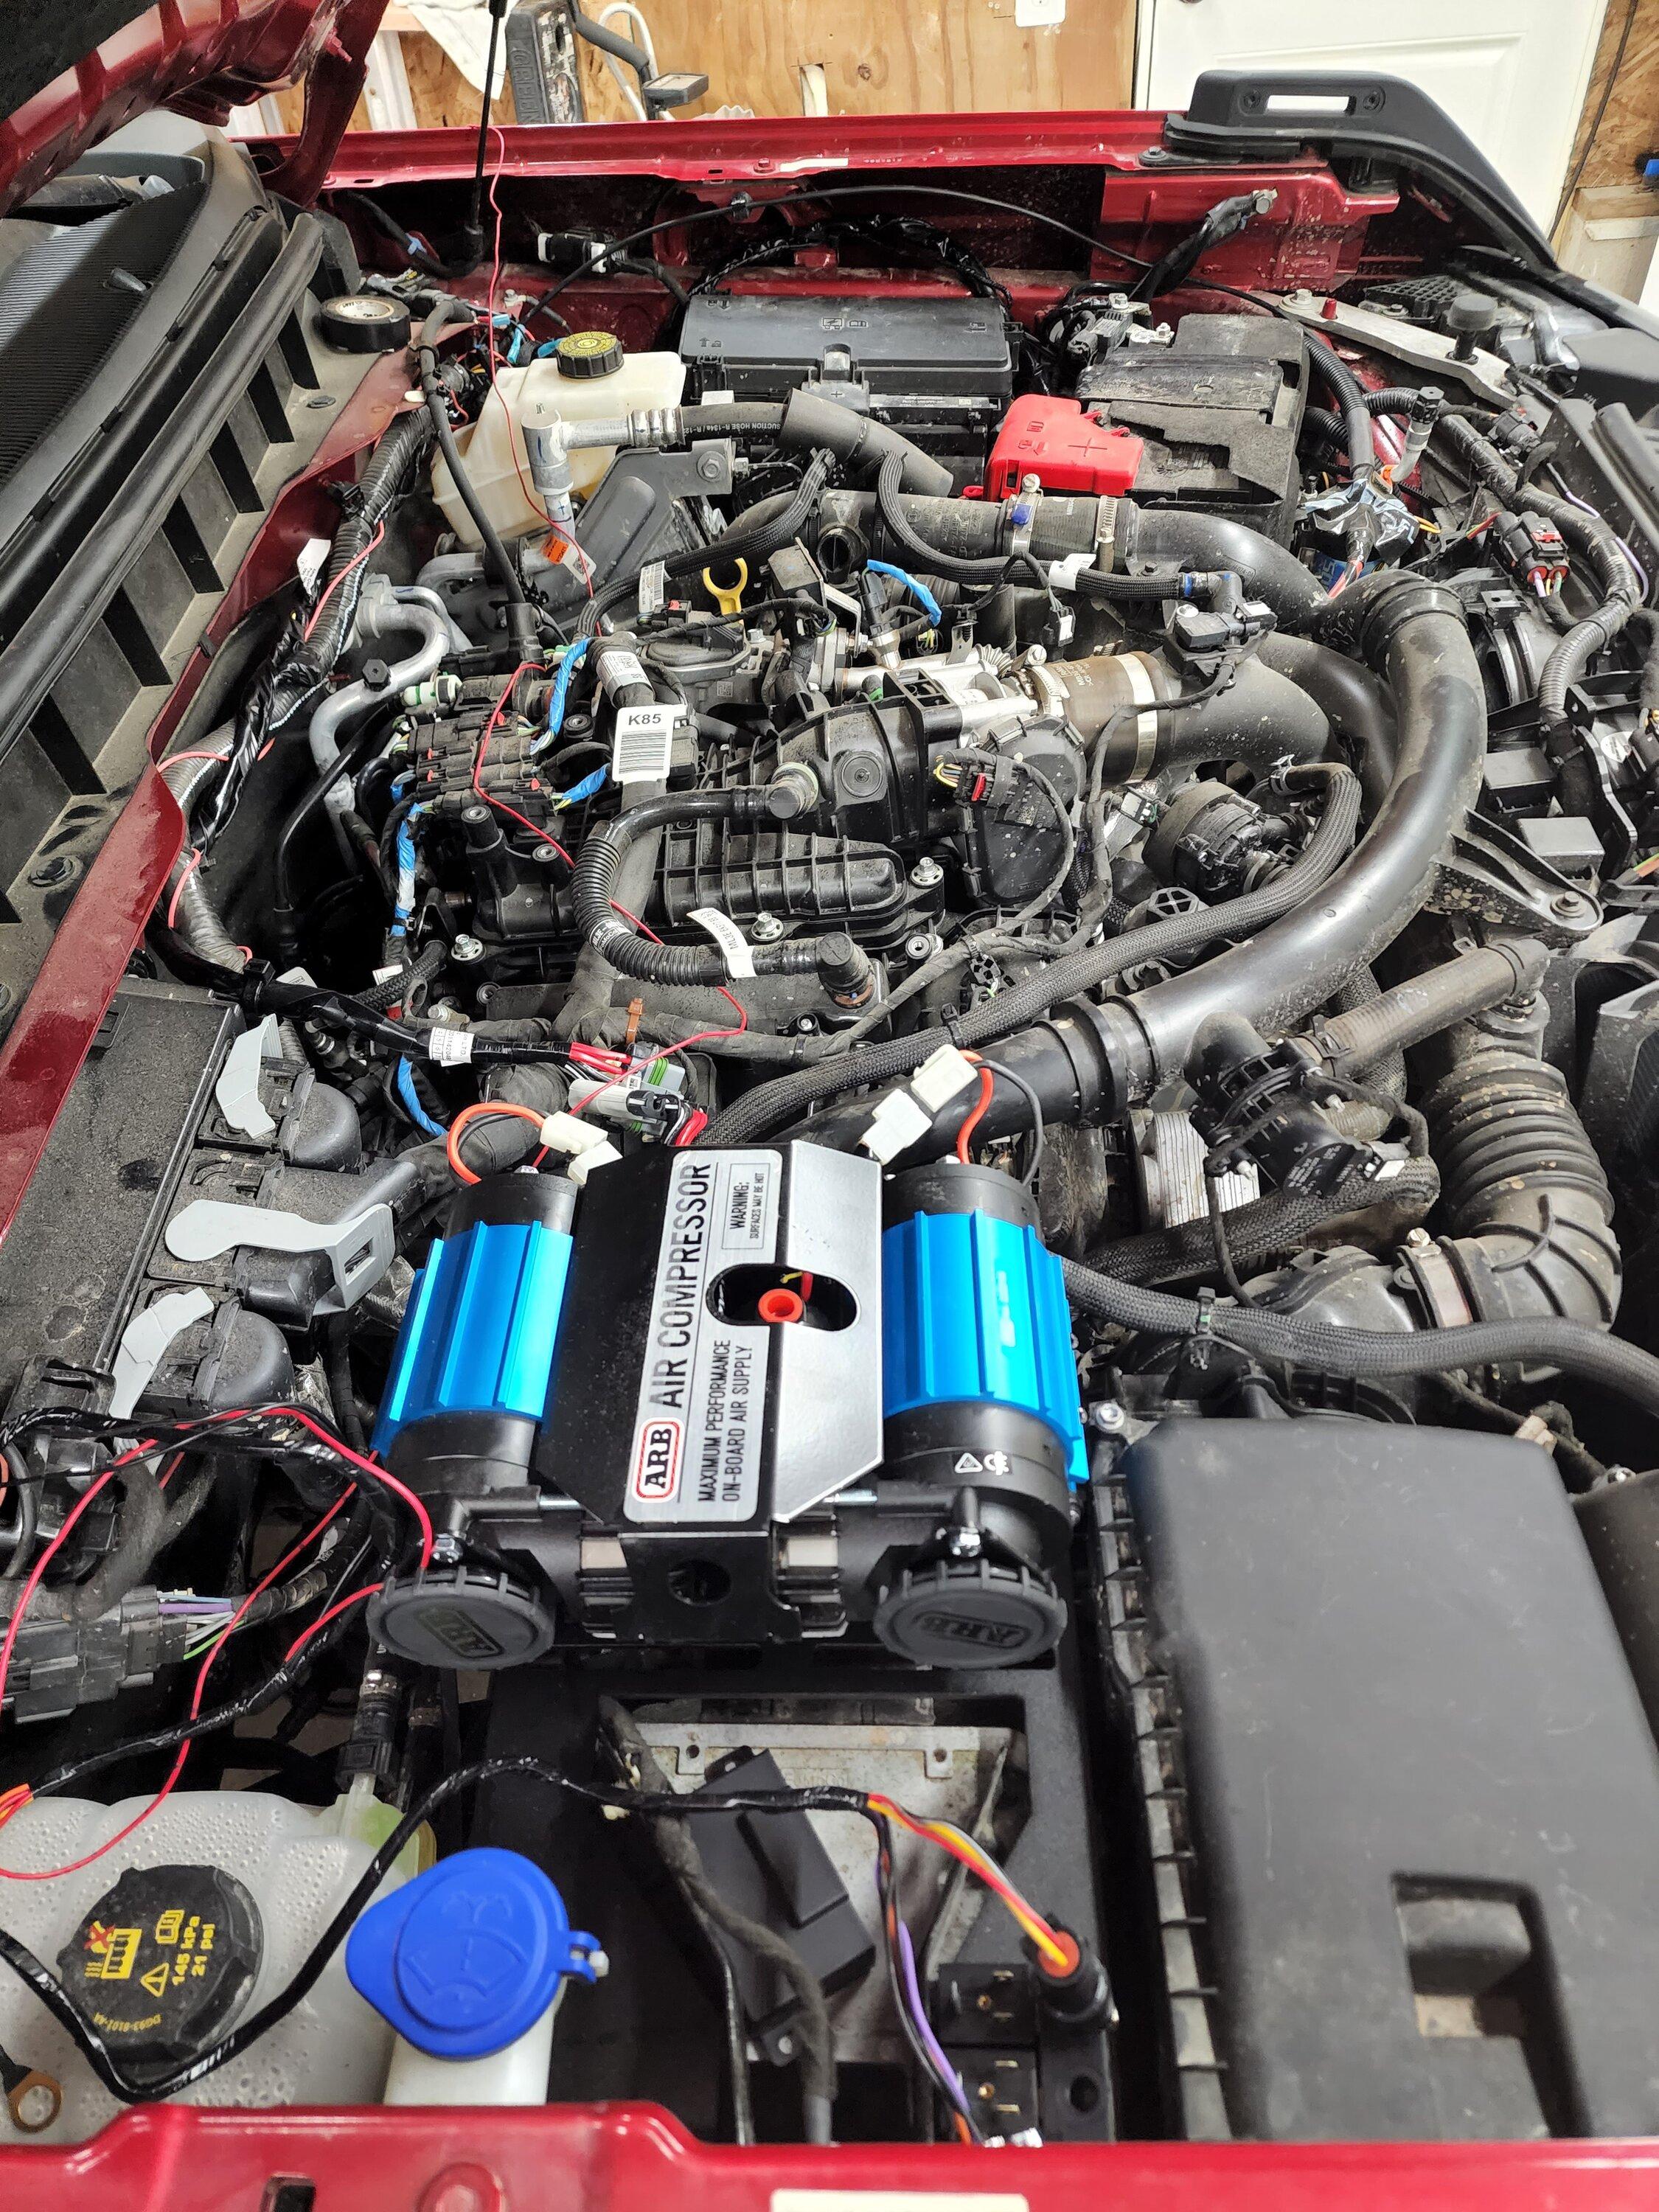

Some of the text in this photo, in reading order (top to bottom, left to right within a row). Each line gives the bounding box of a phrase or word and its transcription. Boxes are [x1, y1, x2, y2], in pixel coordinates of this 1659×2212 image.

[731, 422, 750, 431] HOSE
[751, 422, 781, 431] SUCTION
[628, 713, 661, 726] K85
[730, 1181, 750, 1230] WARNING:
[750, 1172, 765, 1239] SURFACES MAY BE HOT
[650, 1164, 712, 1408] AIR COMPRESSOR
[698, 1339, 731, 1502] MAXIMUM PERFORMANCE
[722, 1346, 753, 1502] ON-BOARD AIR SUPPLY
[644, 1427, 672, 1489] ARB
[172, 1916, 201, 1985] 145 kPa
[191, 1924, 216, 1976] 21 psi
